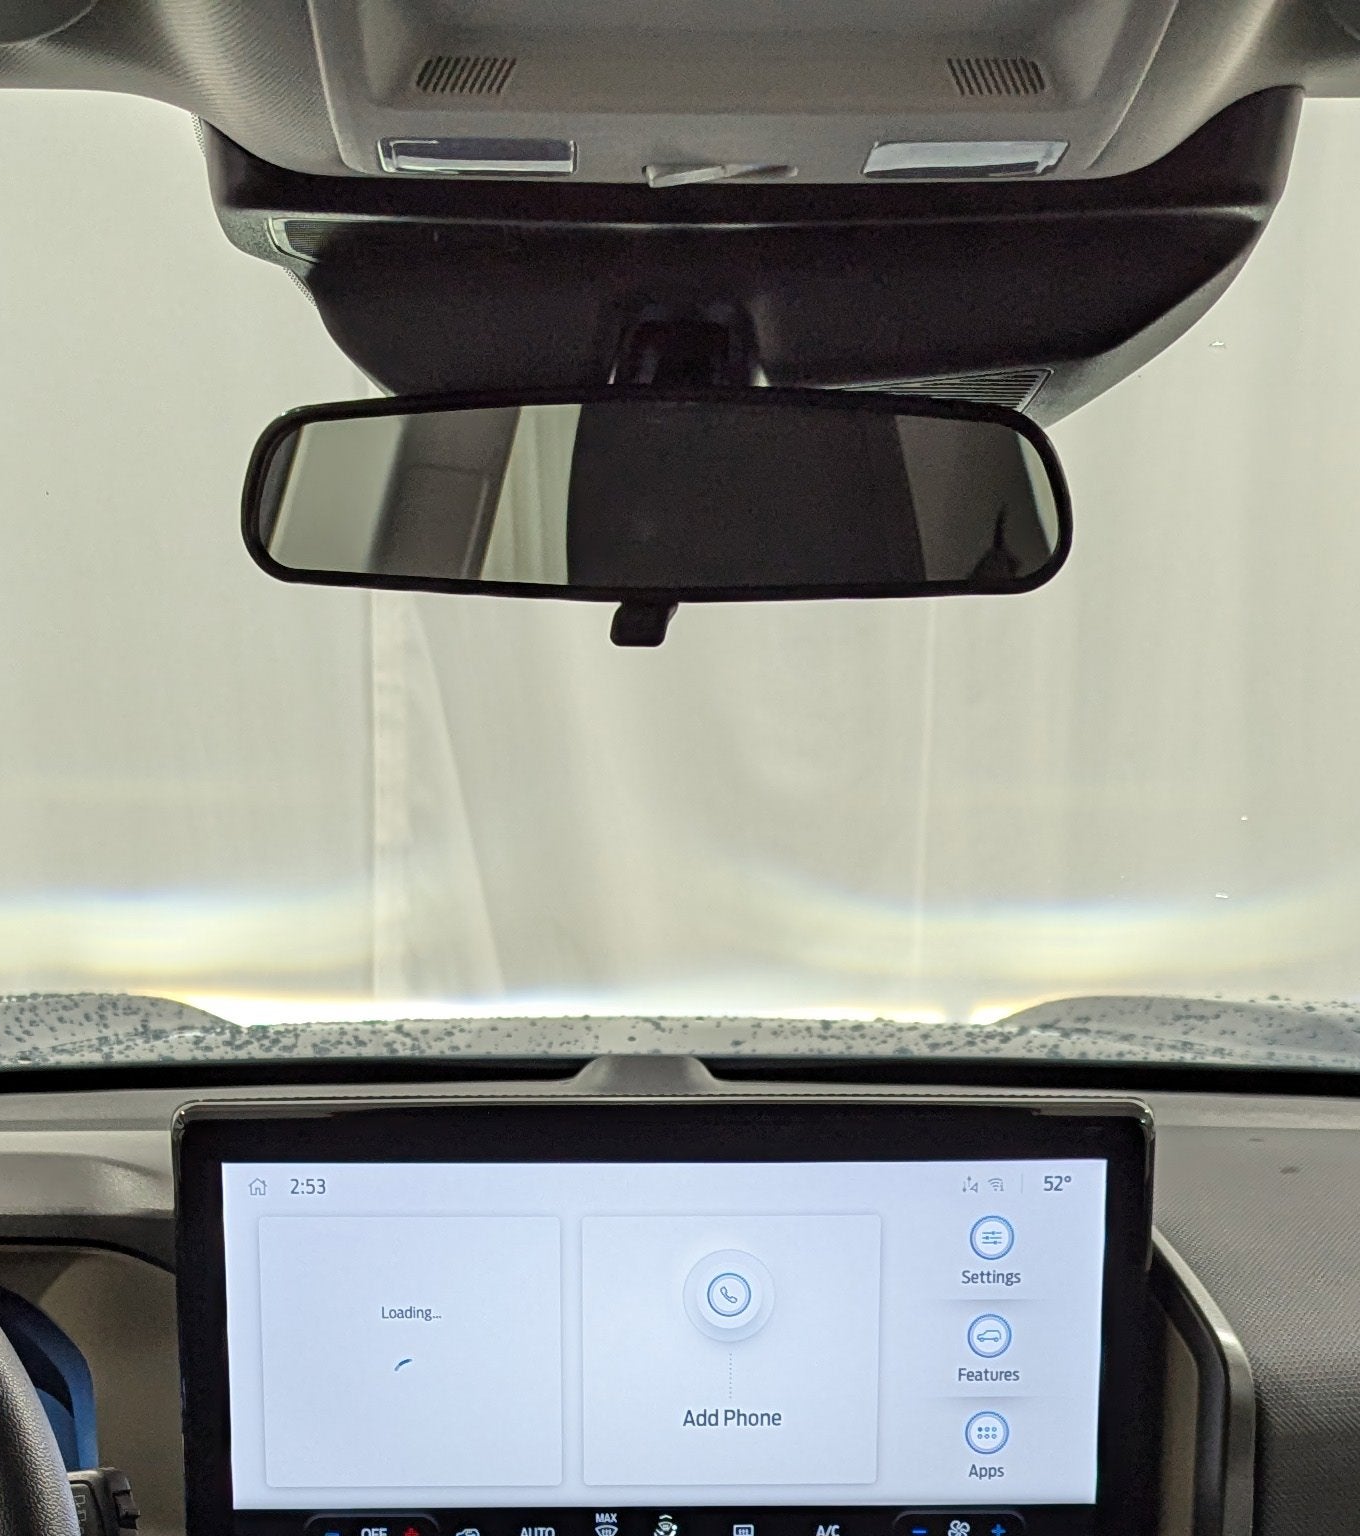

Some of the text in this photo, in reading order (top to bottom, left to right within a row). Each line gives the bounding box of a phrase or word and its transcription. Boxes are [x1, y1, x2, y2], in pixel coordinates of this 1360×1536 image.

[290, 1178, 327, 1195] 2:53
[1043, 1175, 1072, 1193] 52°
[961, 1270, 1021, 1286] Settings
[381, 1306, 442, 1322] Loading...
[957, 1367, 1020, 1382] Features
[683, 1409, 782, 1427] Add Phone
[968, 1463, 1005, 1480] Apps
[595, 1513, 618, 1523] MAX
